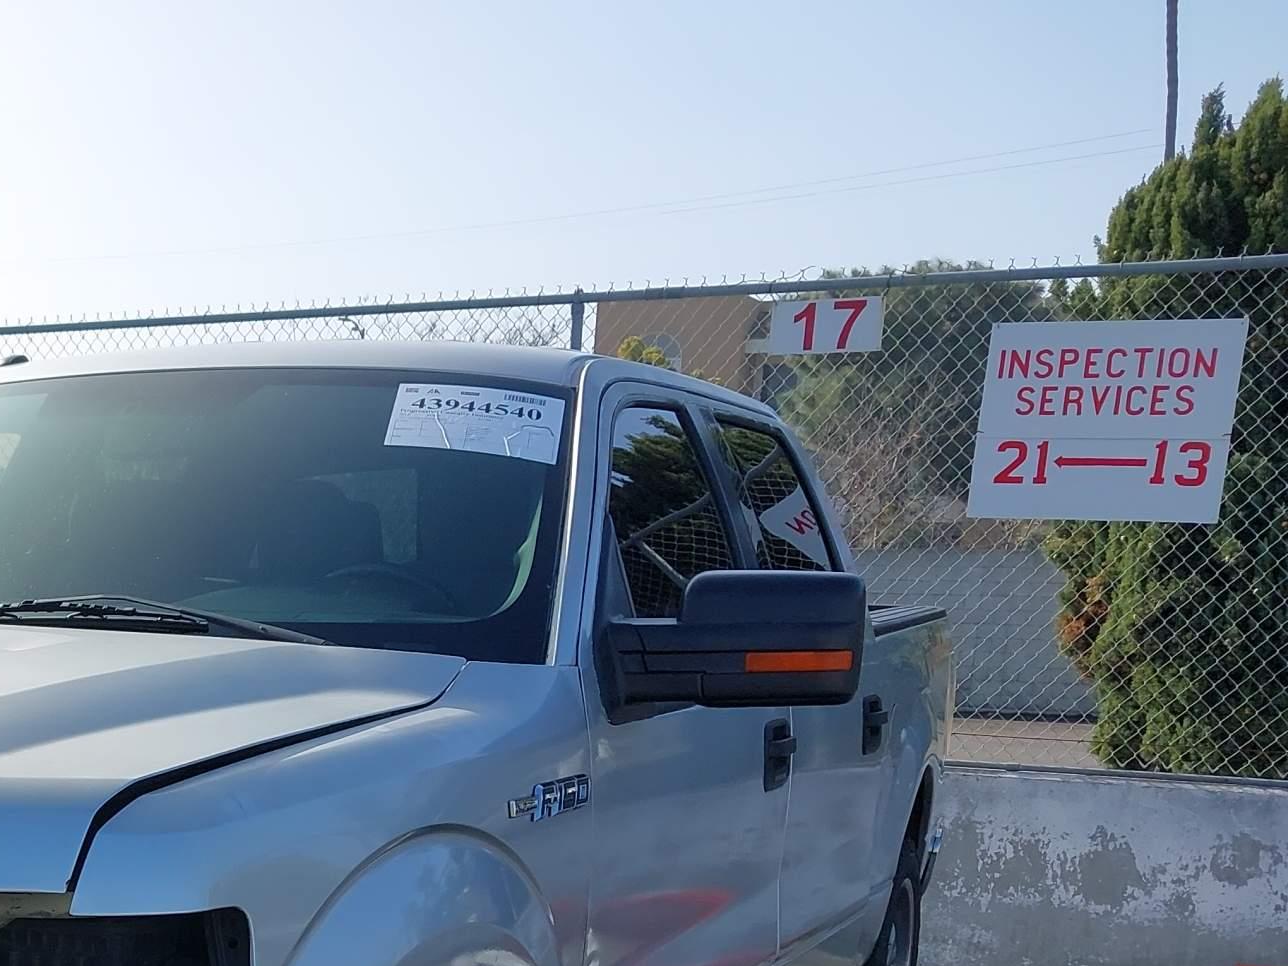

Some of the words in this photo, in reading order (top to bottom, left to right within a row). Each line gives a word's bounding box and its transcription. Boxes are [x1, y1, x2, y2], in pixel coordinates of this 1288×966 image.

[793, 299, 868, 352] 17
[996, 347, 1219, 379] INSPECTION
[411, 397, 543, 421] 43944540
[1015, 385, 1195, 416] SERVICES
[992, 440, 1050, 485] 21
[1149, 440, 1213, 487] 13
